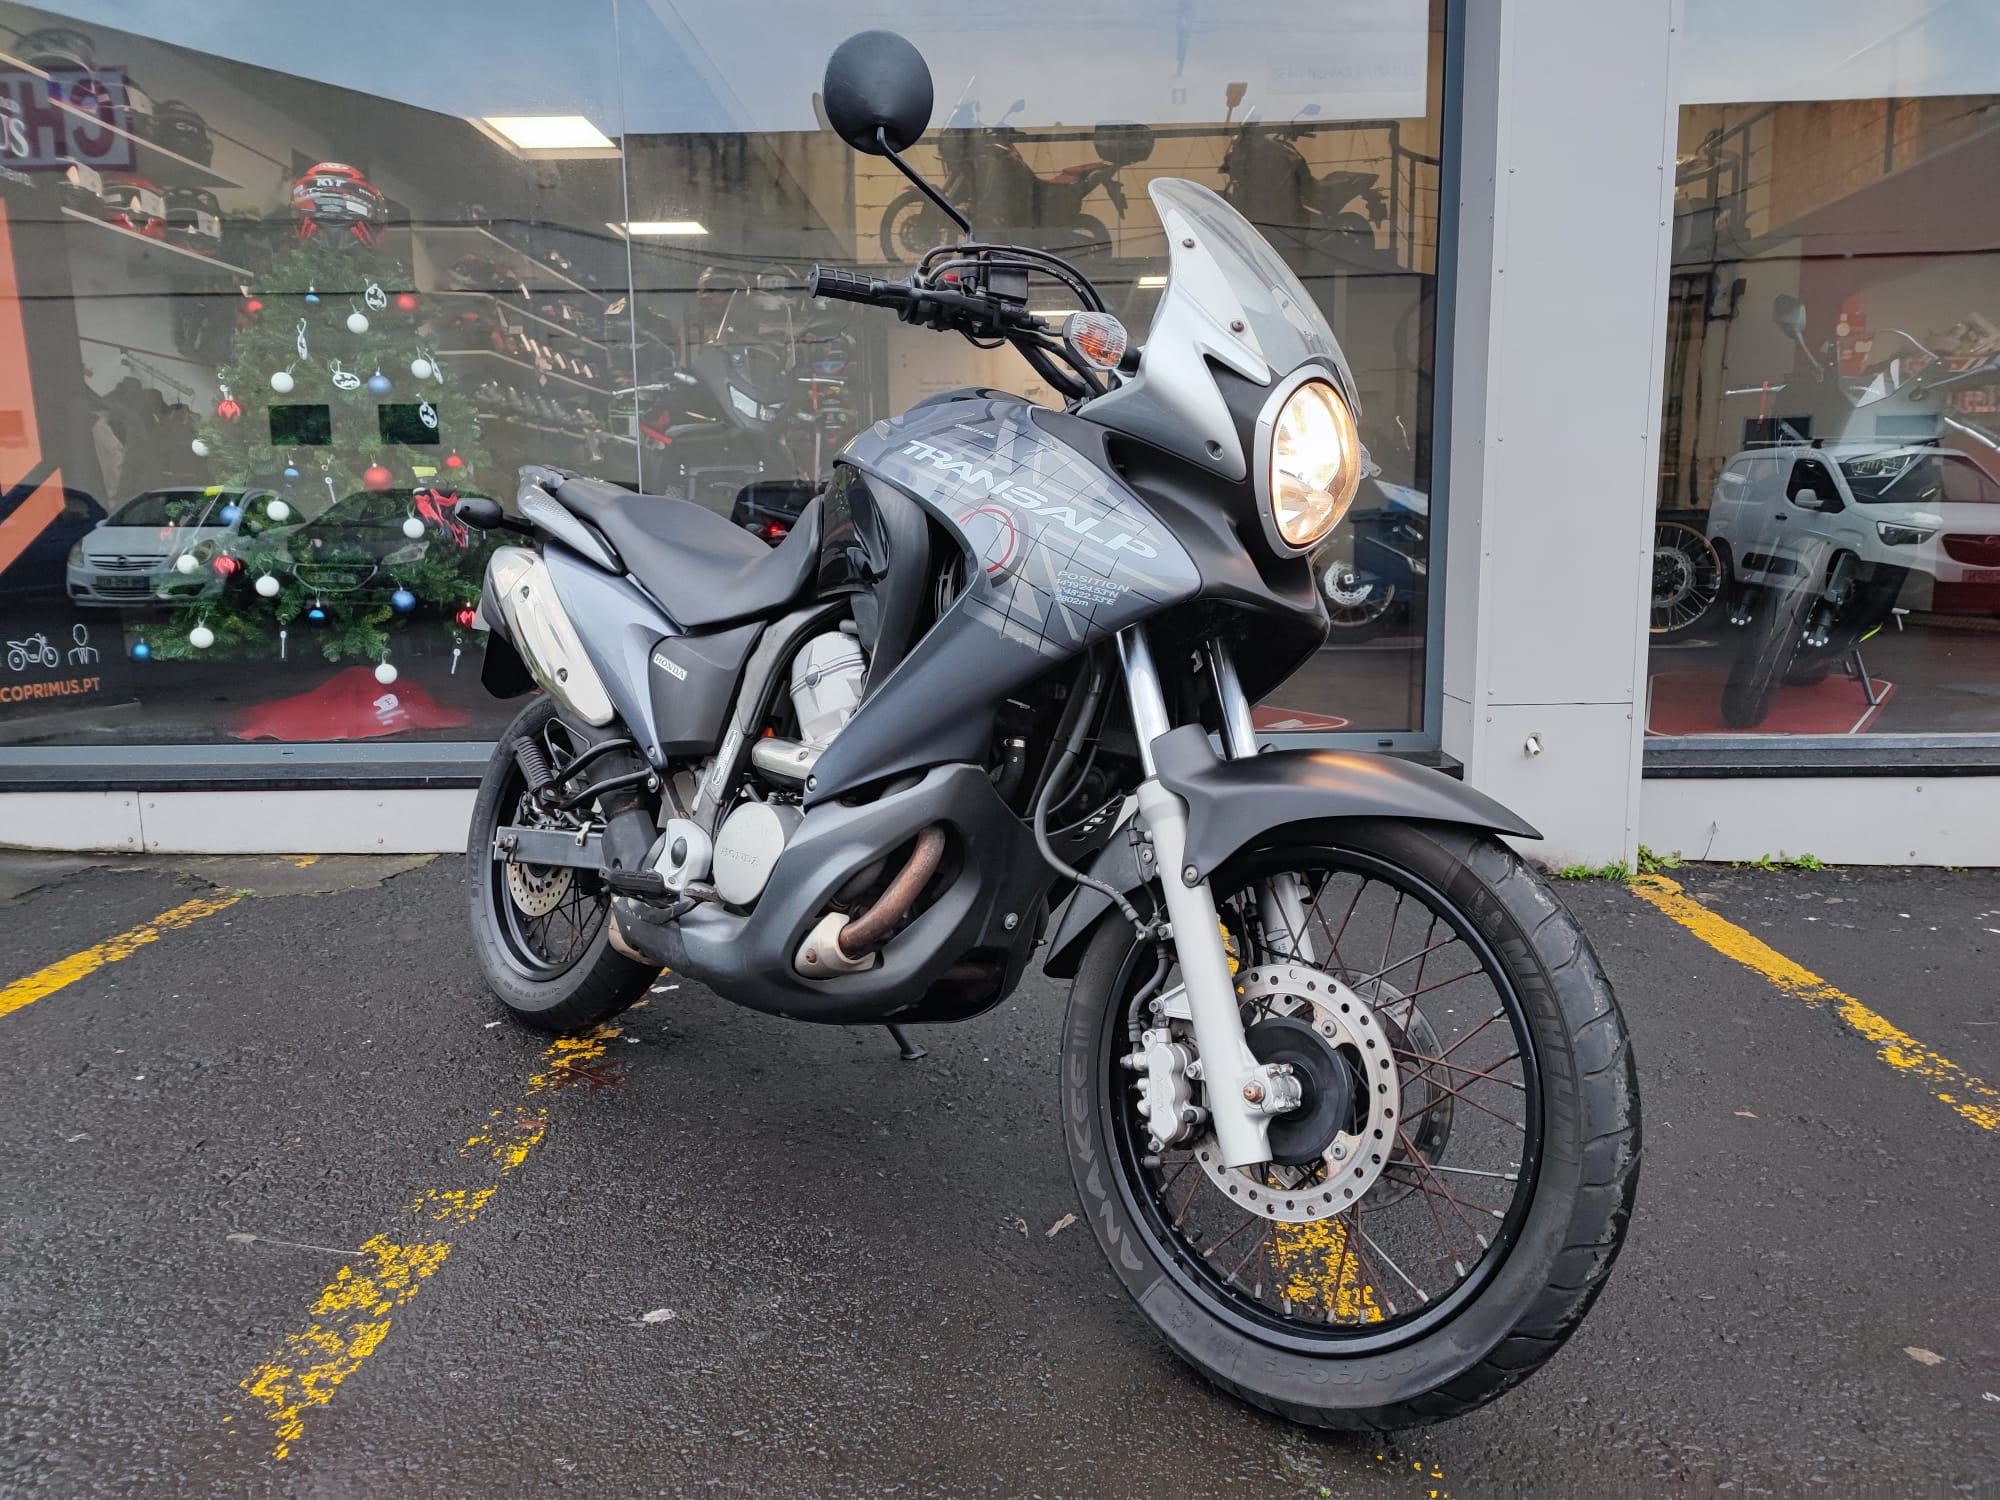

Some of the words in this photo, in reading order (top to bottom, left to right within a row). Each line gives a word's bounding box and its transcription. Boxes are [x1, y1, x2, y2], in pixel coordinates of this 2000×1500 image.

[902, 440, 1157, 559] TRANSALP
[1057, 571, 1129, 592] POSITION
[0, 677, 100, 702] COPRIMUS.PT
[654, 653, 687, 680] HONDA
[1503, 937, 1579, 1153] MICHELIN
[1071, 1053, 1144, 1271] ANAKEE
